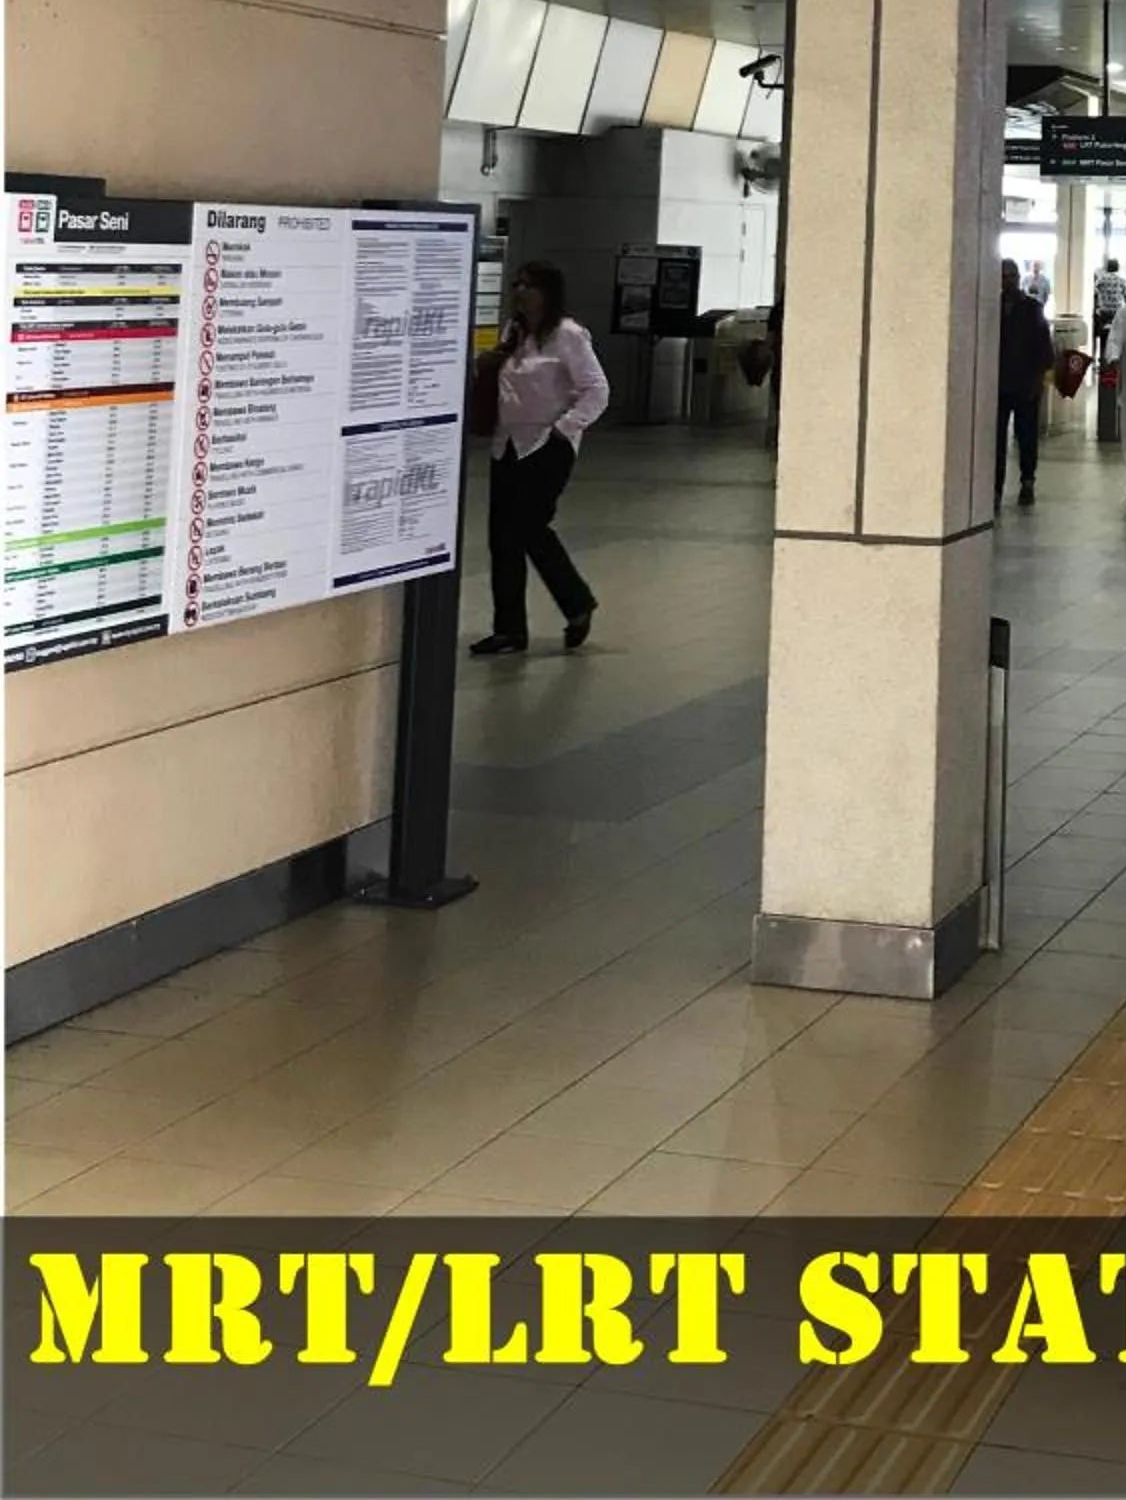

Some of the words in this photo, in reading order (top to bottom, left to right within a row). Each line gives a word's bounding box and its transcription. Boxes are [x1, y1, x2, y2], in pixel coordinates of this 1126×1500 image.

[58, 210, 98, 230] Pasar
[100, 211, 129, 231] Seni
[207, 210, 266, 233] Dilarang
